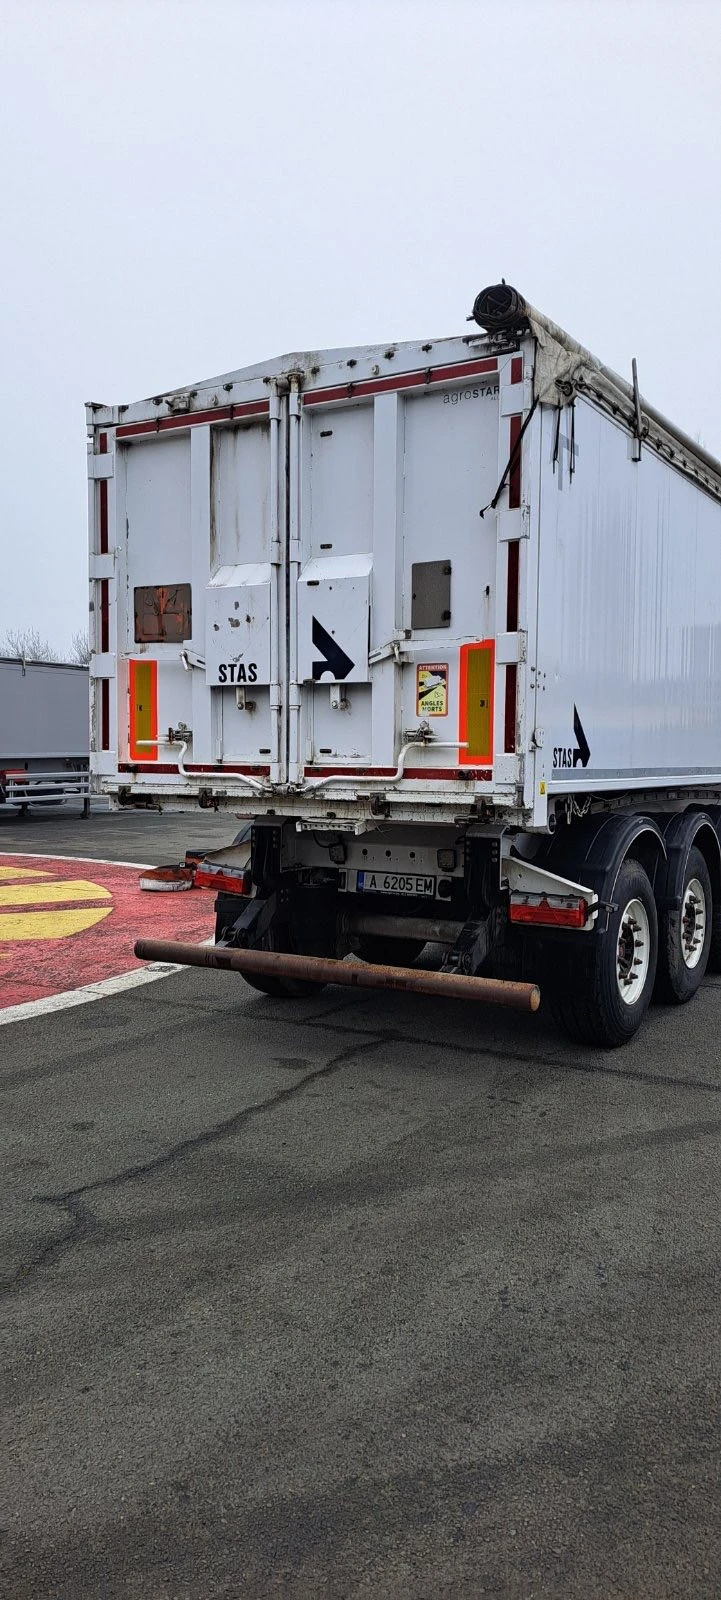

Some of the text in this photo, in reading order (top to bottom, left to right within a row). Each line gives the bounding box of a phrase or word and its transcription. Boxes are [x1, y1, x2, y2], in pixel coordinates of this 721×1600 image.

[218, 663, 258, 683] STAS
[553, 747, 573, 768] STAS
[369, 874, 377, 889] A
[383, 875, 413, 891] 6205
[415, 877, 433, 893] EM
